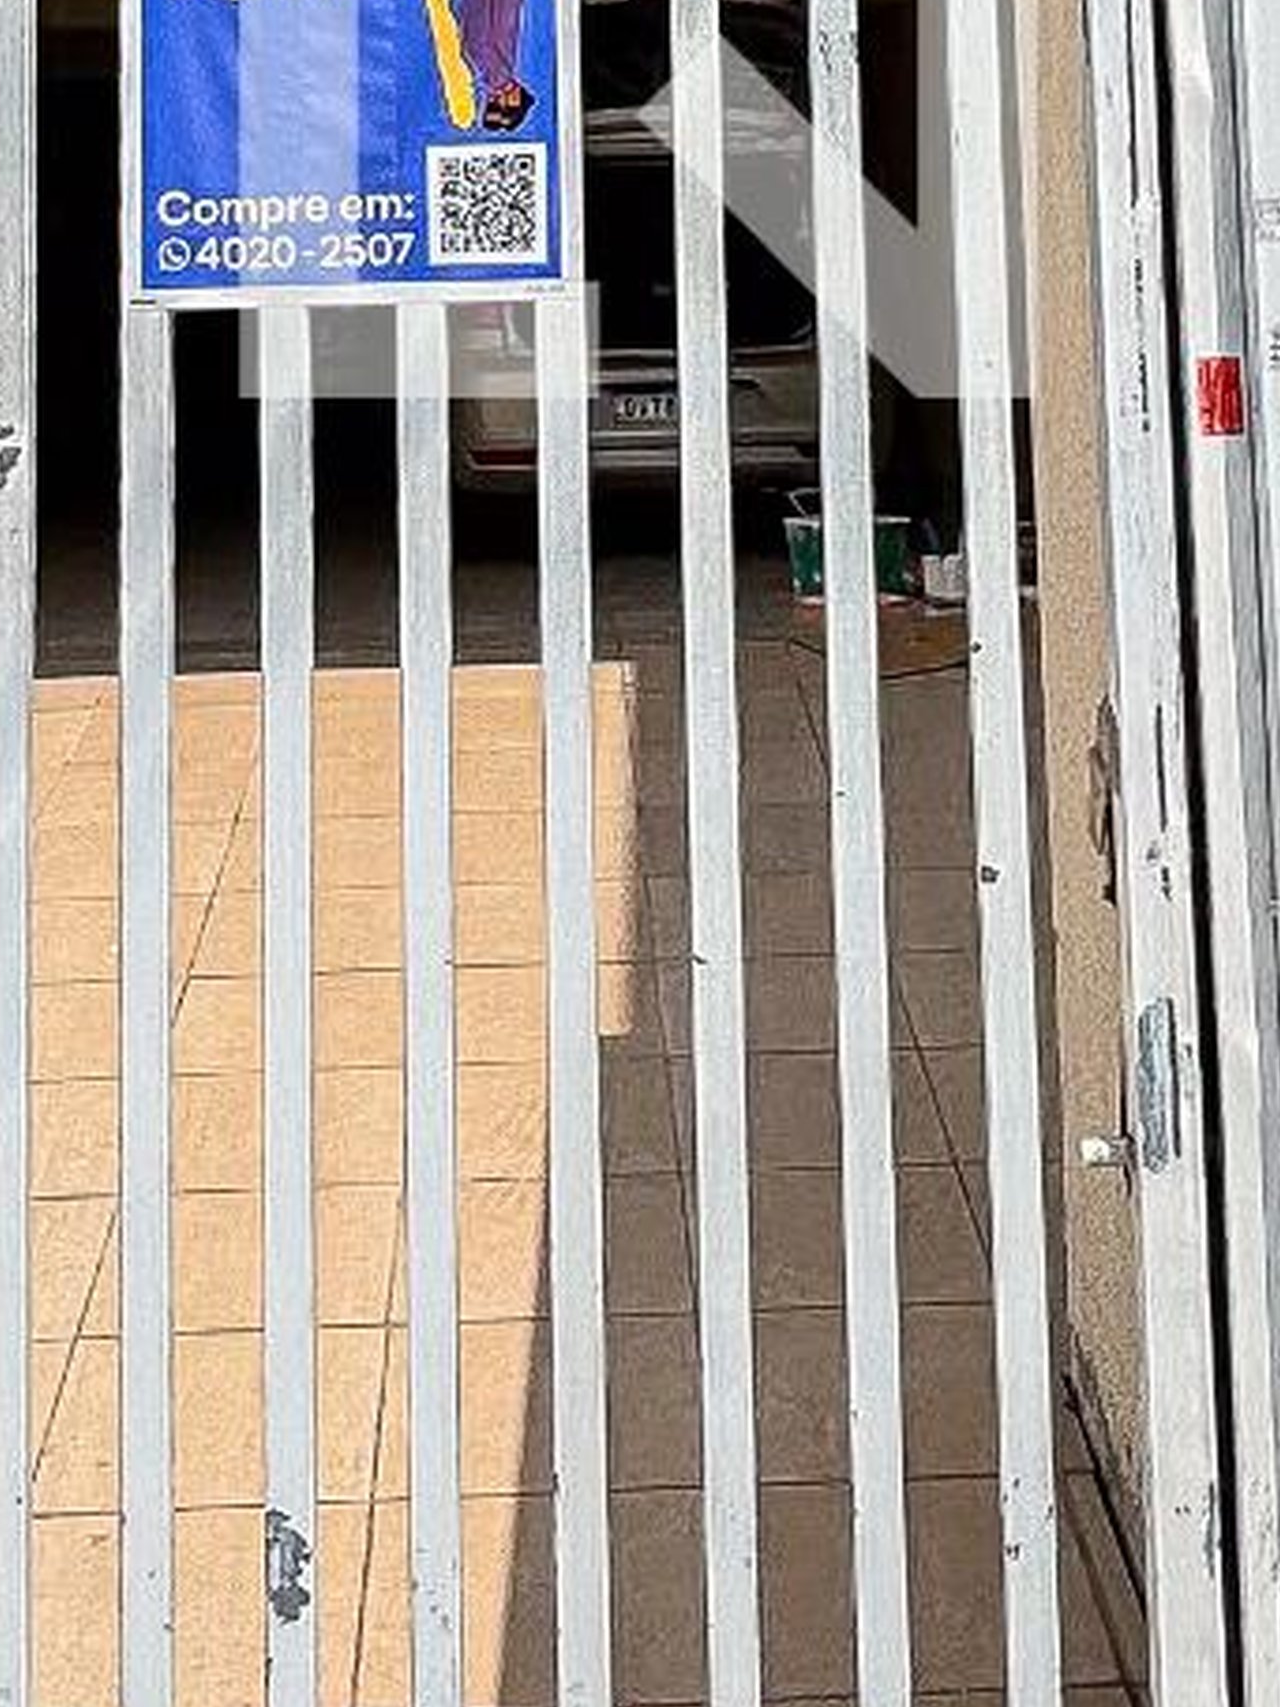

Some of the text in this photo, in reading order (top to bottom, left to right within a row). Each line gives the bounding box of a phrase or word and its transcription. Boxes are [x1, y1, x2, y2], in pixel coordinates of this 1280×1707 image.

[156, 190, 416, 229] Compre em:
[195, 232, 415, 272] 4020-2507
